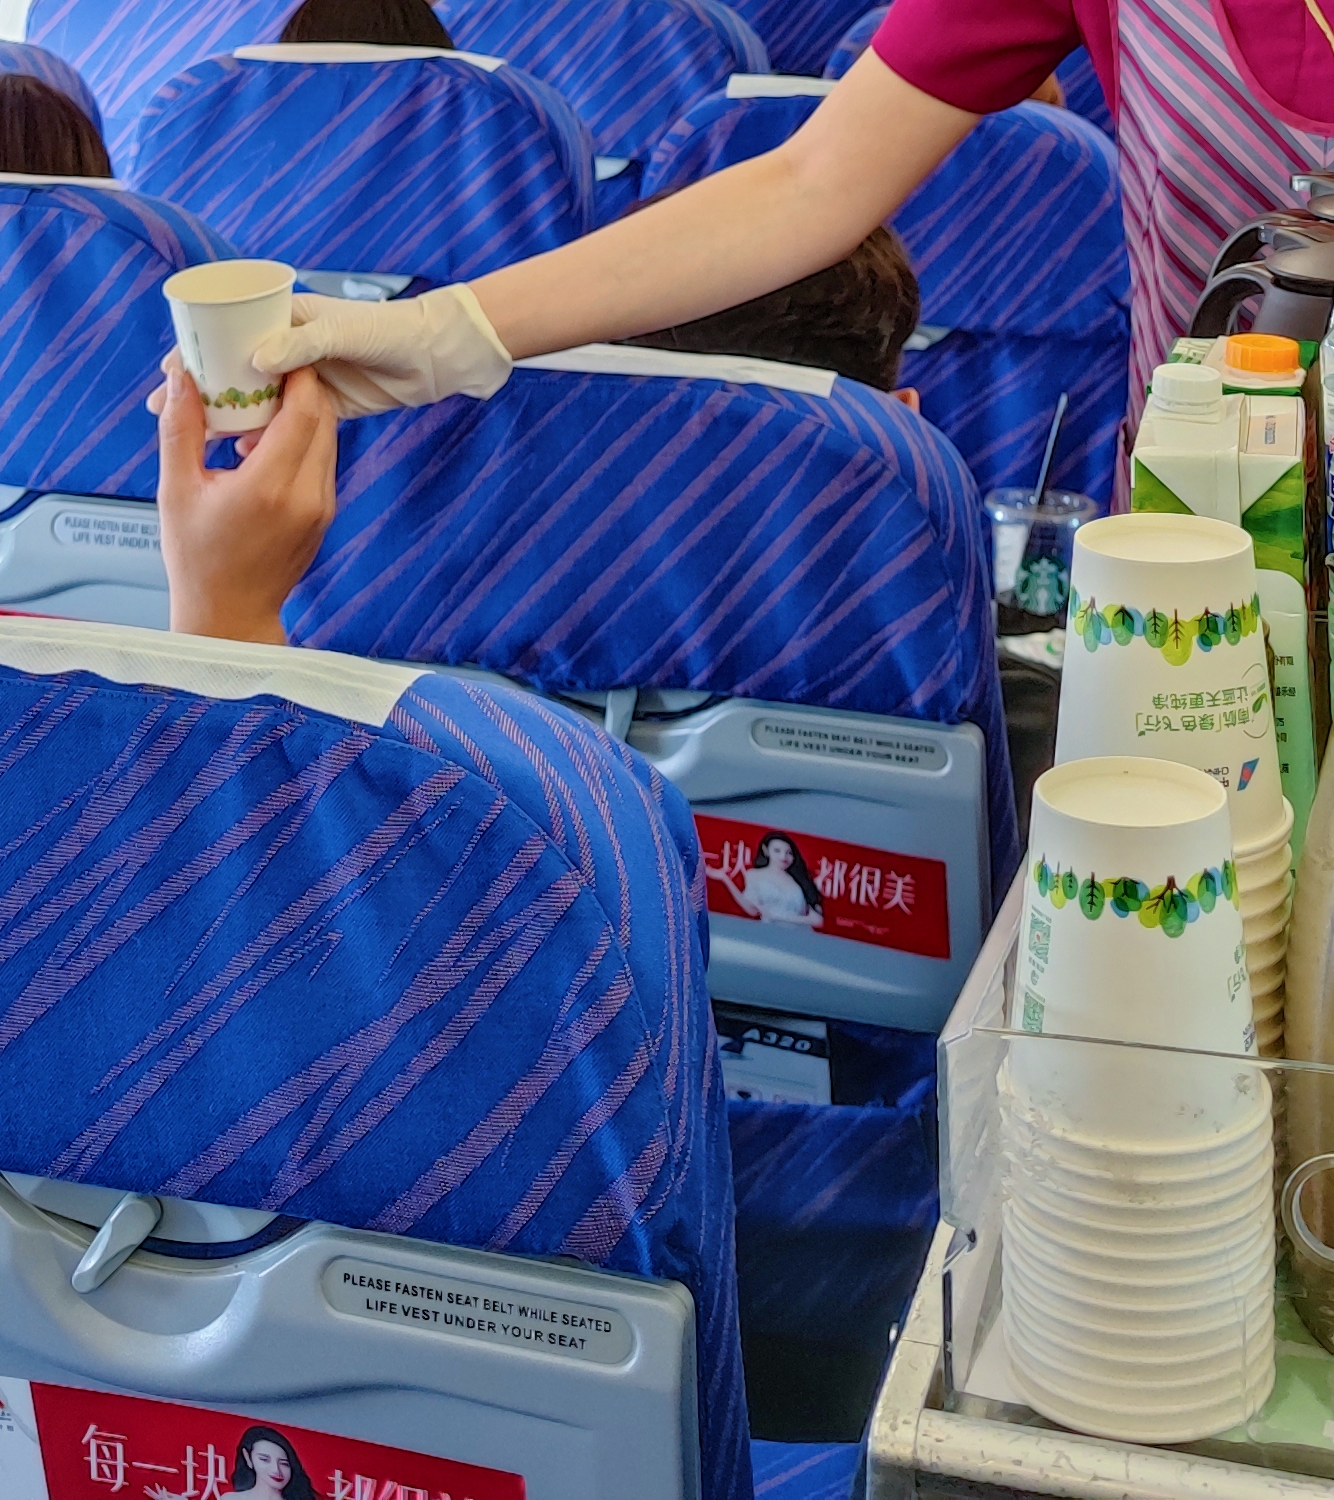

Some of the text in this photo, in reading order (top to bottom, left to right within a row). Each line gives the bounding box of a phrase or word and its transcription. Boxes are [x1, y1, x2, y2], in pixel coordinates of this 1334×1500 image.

[1152, 686, 1249, 711] 让蓝天更纯净
[815, 855, 917, 916] 都很美
[343, 1273, 612, 1333] PLEASE FASTEN SEAT BELT WHILE SEATED
[366, 1298, 587, 1350] LIFE VEST UNDER YOUR SEAT
[81, 1424, 230, 1500] 每一块
